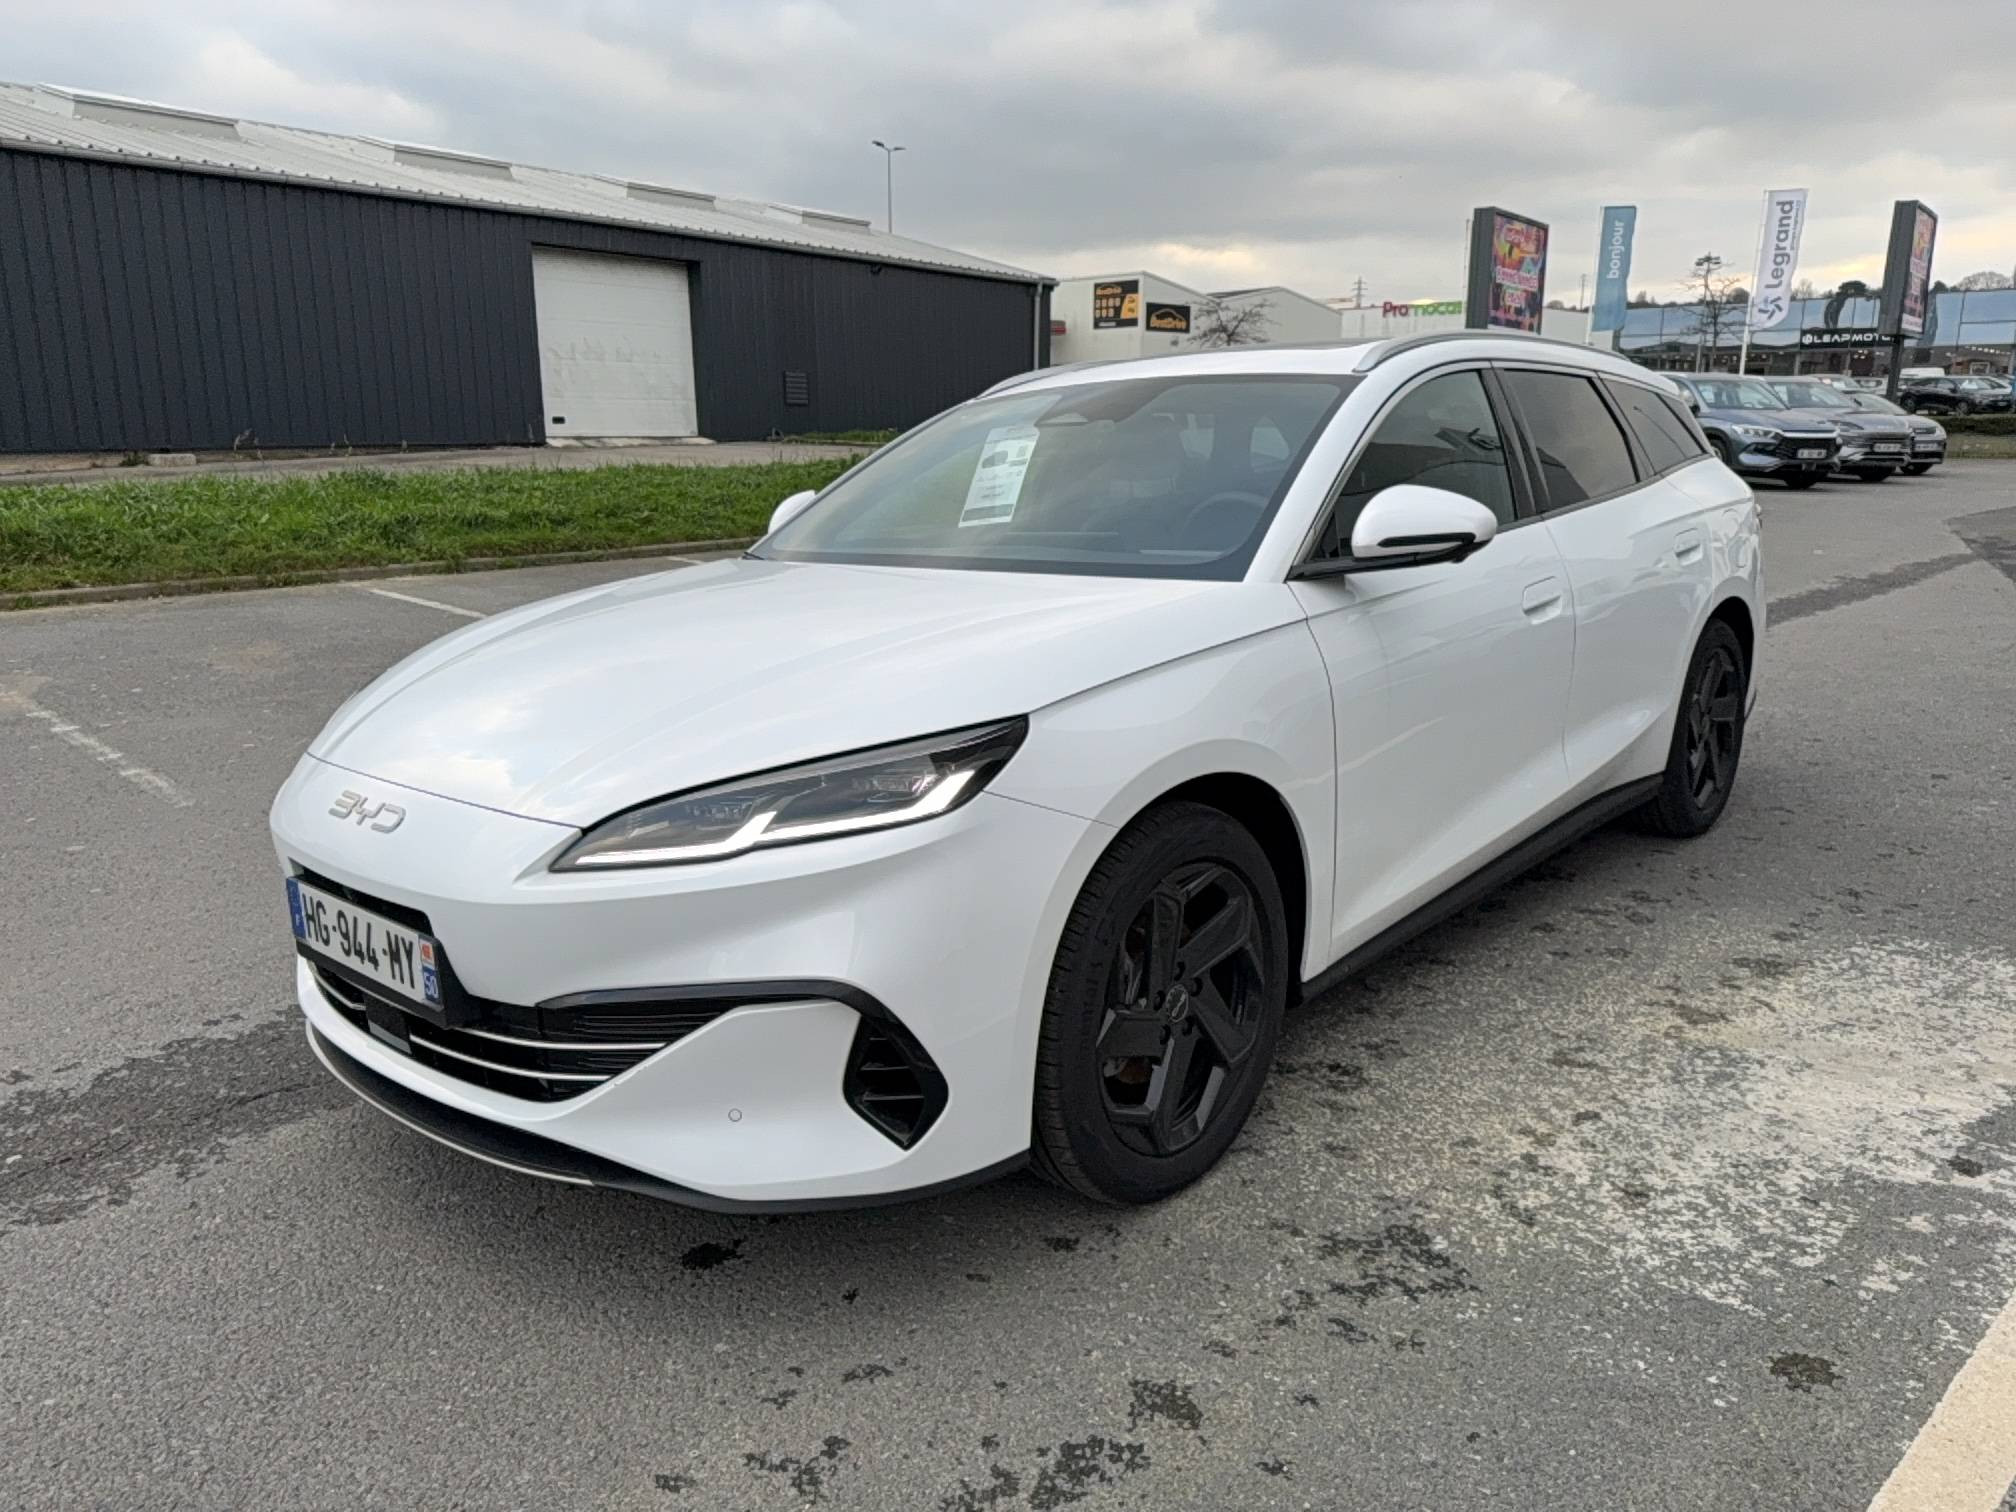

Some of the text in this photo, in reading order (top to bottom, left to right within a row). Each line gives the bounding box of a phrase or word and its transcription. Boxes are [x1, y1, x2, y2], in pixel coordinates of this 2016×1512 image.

[1607, 220, 1625, 278] bonjour
[1765, 200, 1794, 288] Legrand
[1813, 333, 1894, 343] LEAPMOTO
[328, 790, 406, 834] BYD
[302, 893, 415, 989] HG-944-MY
